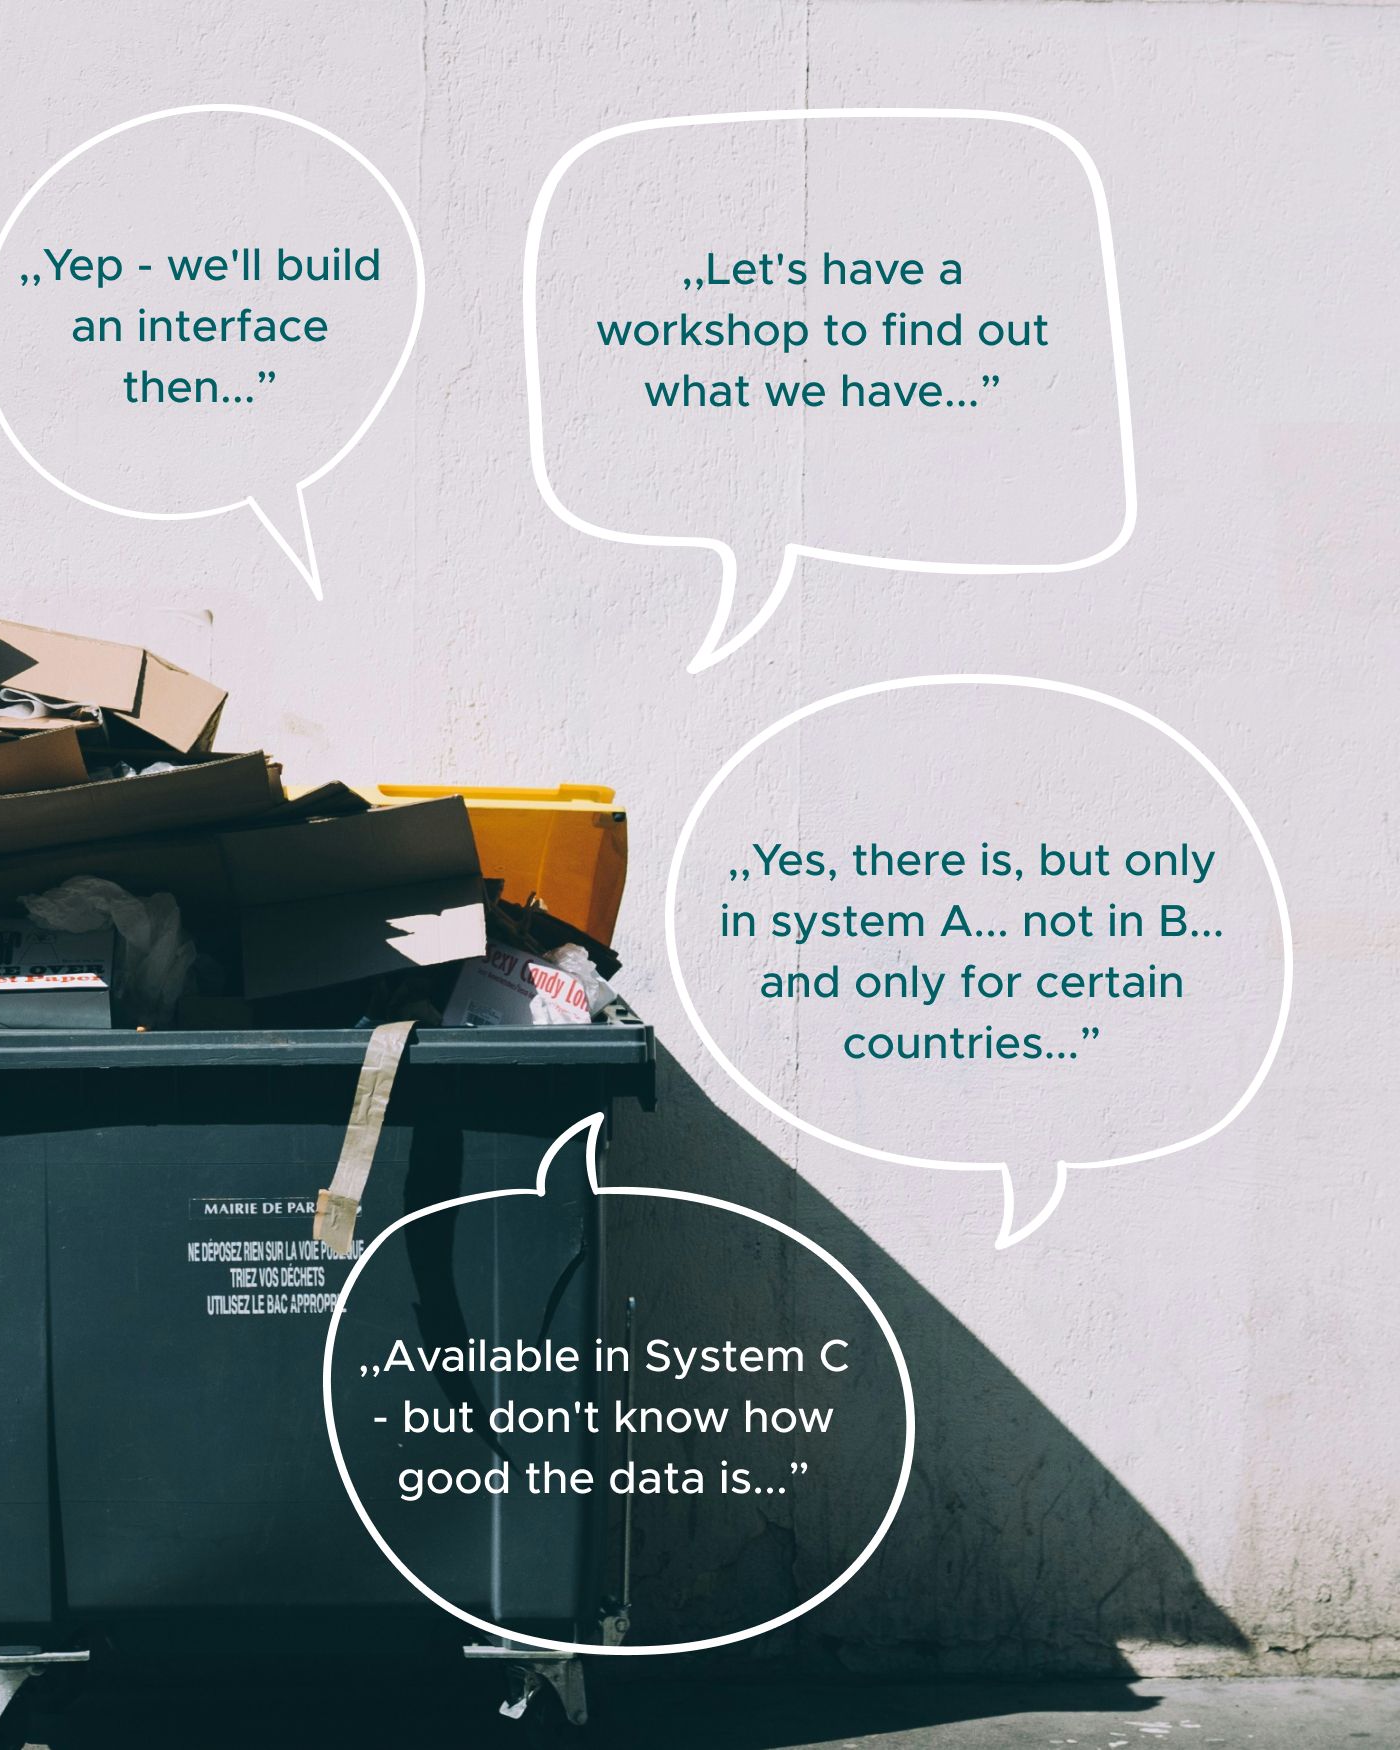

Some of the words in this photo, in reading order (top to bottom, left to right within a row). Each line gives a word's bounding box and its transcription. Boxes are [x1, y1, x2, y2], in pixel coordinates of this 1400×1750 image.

[24, 974, 103, 984] Paper
[29, 964, 105, 976] OVER
[520, 959, 564, 999] Candy
[204, 1203, 258, 1214] MAIRIE
[262, 1202, 283, 1214] DE
[287, 1202, 317, 1214] PAR
[188, 1241, 200, 1262] NE
[201, 1238, 243, 1262] DÉPOSEZ
[244, 1240, 265, 1262] RIEN
[265, 1240, 284, 1261] SUR
[285, 1240, 298, 1261] LA
[299, 1240, 320, 1261] VOIE
[230, 1267, 258, 1288] TRIEZ
[259, 1266, 279, 1288] VOS
[281, 1262, 325, 1287] DÉCHETS
[207, 1294, 250, 1316] UTILISEZ
[252, 1294, 265, 1315] LE
[267, 1293, 288, 1314] BAC
[290, 1292, 347, 1314] APPROPR
